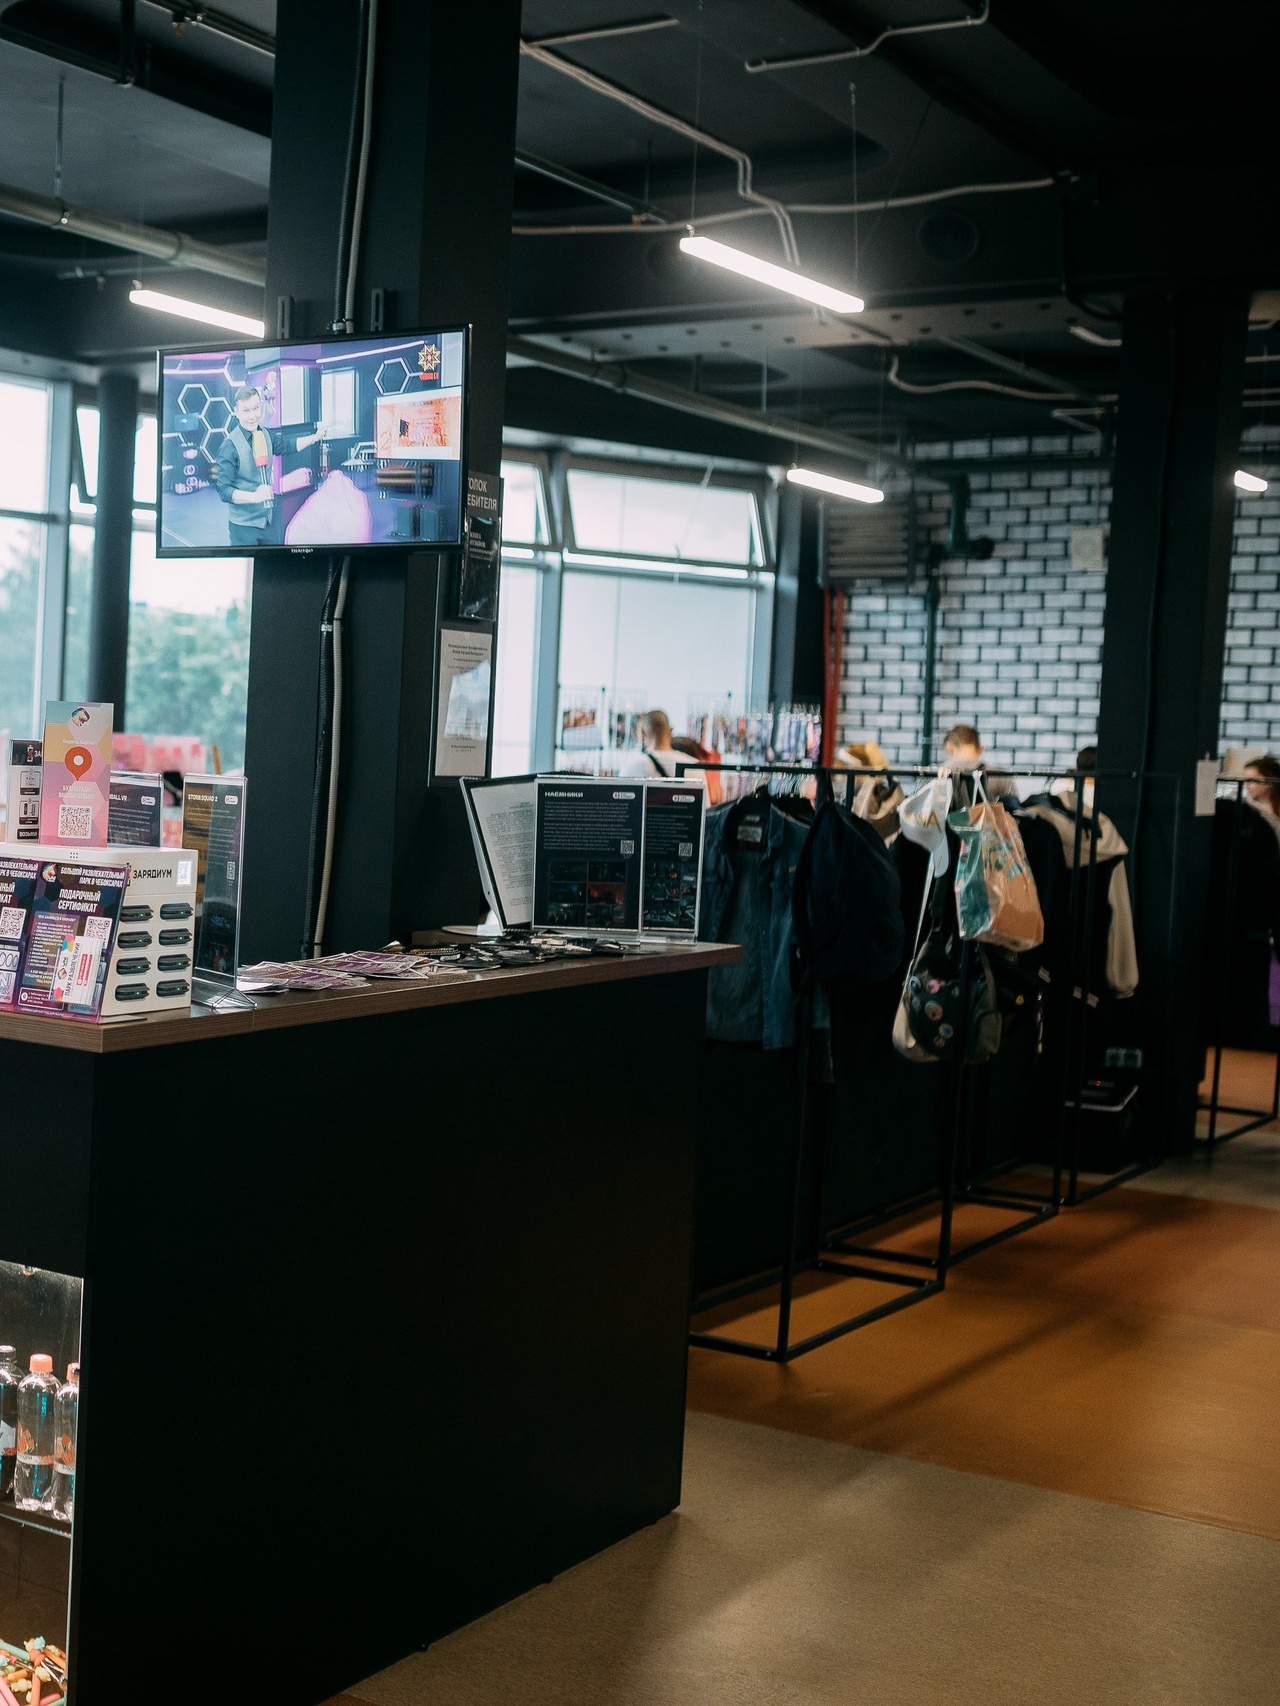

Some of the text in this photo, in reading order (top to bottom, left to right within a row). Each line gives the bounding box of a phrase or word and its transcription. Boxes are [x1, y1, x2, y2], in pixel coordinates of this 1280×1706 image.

[468, 477, 488, 492] ОЛОК
[467, 493, 497, 511] ЕБИТЕЛЯ
[133, 869, 172, 879] ЗАРЯДИУМ
[59, 888, 101, 902] ПОДАРОЧНЫЙ
[58, 900, 98, 913] СЕРТИФИКАТ
